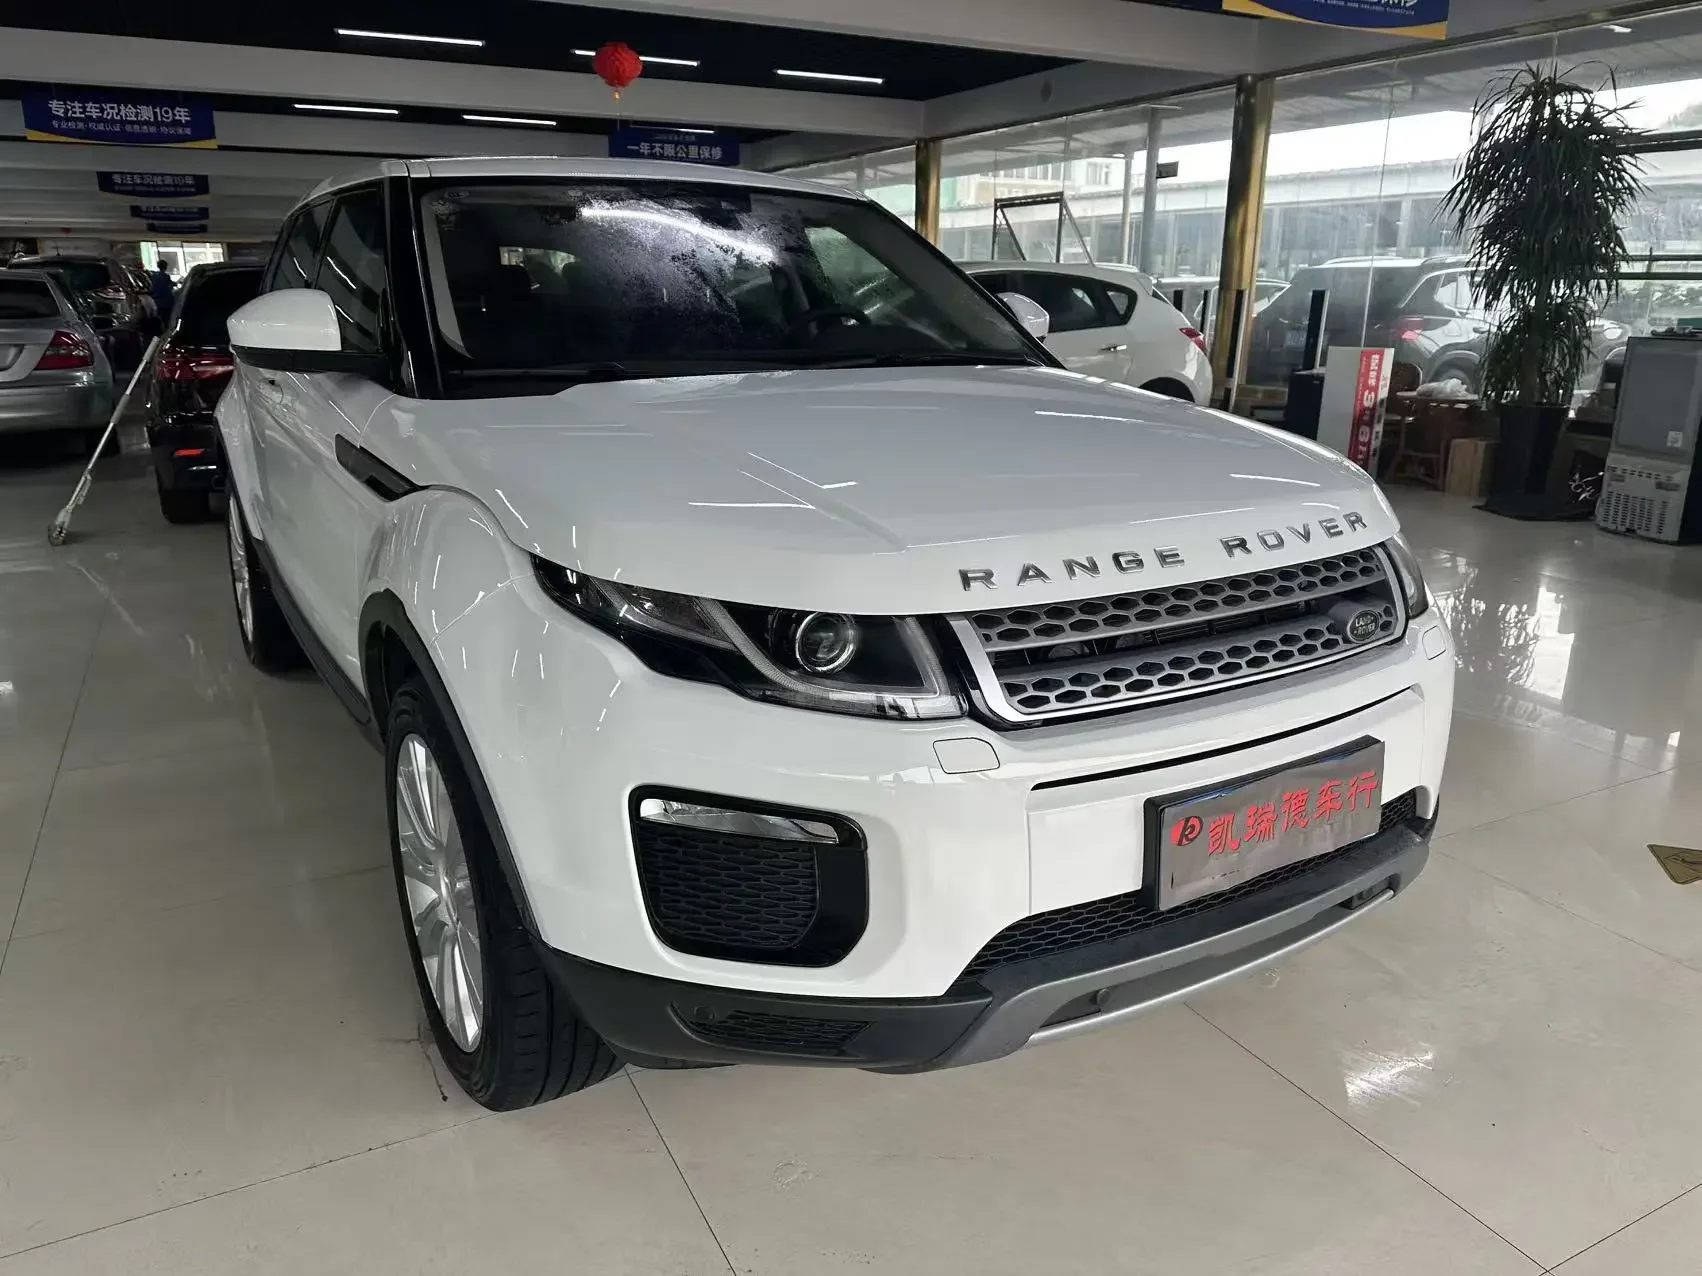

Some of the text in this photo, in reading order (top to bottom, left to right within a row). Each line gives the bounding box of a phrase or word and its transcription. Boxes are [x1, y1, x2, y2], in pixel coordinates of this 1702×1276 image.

[48, 100, 191, 123] 专注车况检测19年
[627, 142, 723, 159] 一年不限公里保修
[958, 511, 1368, 591] RANGE ROVER
[1208, 770, 1379, 856] 凯瑞德车行
